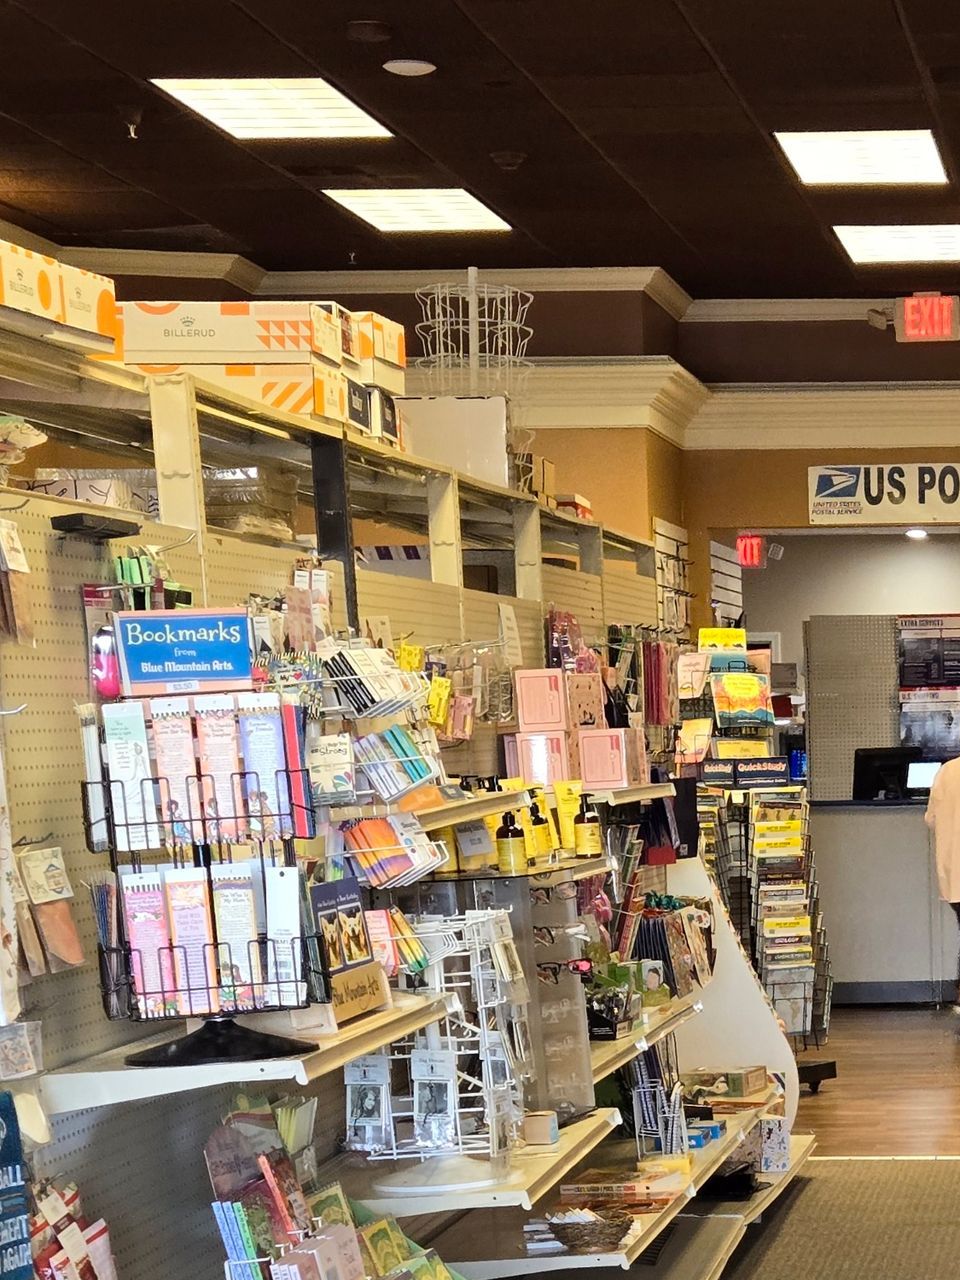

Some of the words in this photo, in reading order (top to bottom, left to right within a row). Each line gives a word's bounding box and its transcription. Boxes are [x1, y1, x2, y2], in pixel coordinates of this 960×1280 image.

[905, 297, 953, 336] EXIT
[163, 328, 216, 338] BILLERUD
[863, 466, 906, 505] US
[126, 621, 241, 645] Bookmarks
[174, 647, 197, 657] from
[141, 662, 163, 673] Blue
[164, 661, 211, 672] Mountain
[738, 762, 787, 773] QuickStudy
